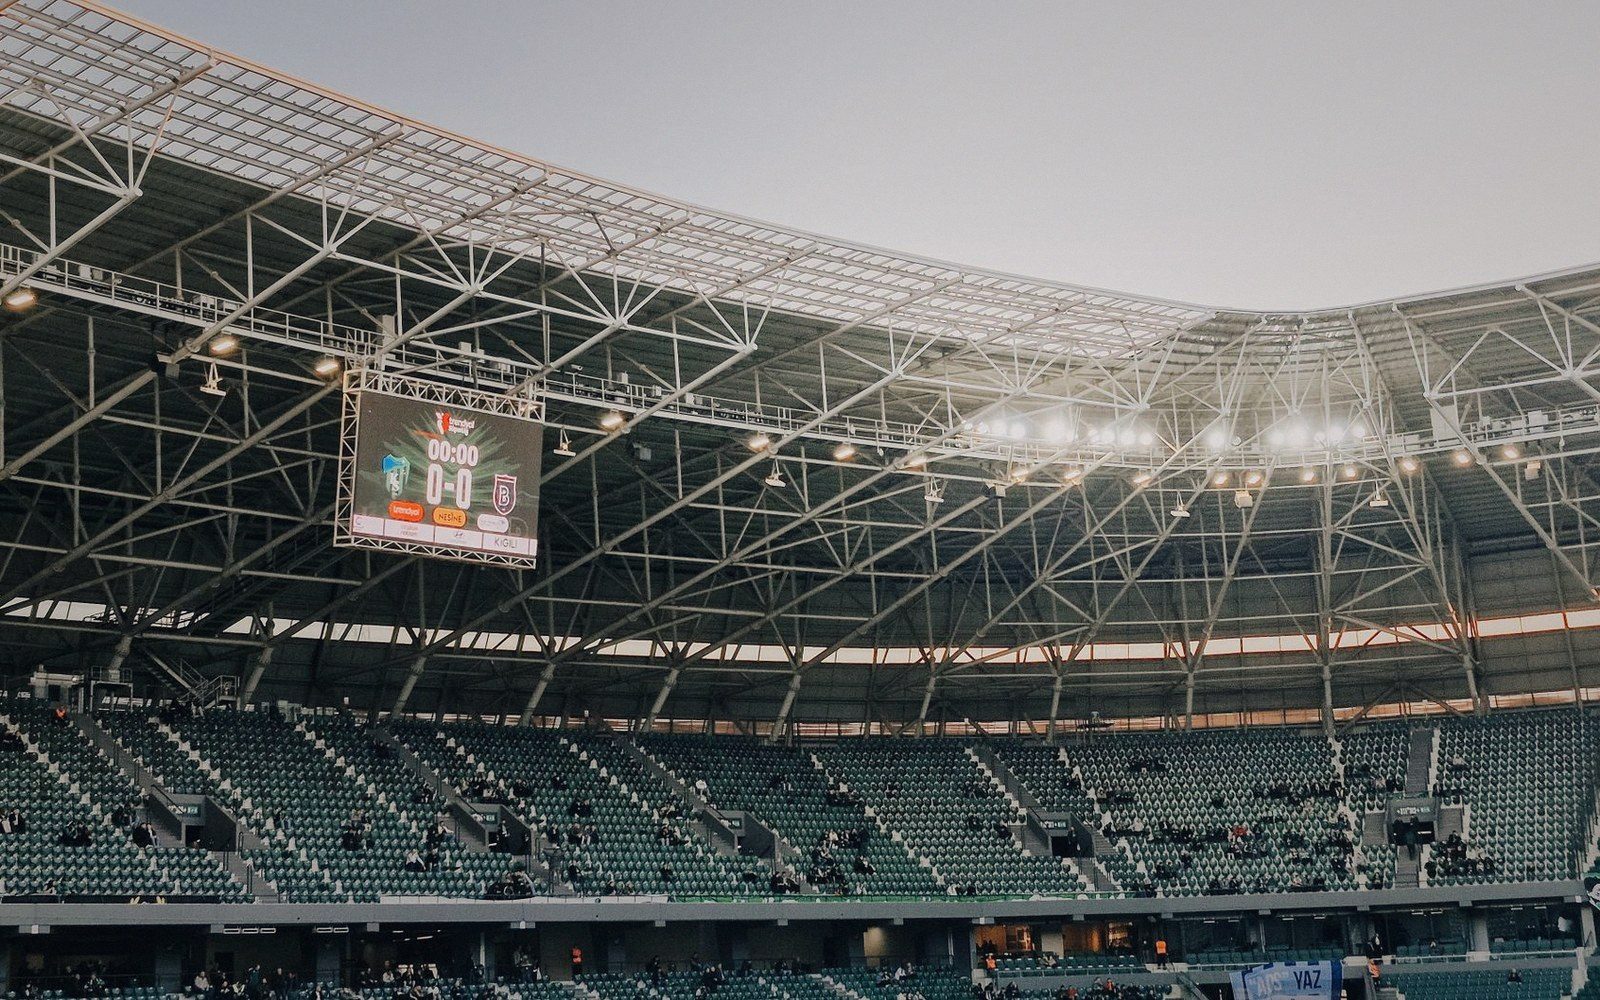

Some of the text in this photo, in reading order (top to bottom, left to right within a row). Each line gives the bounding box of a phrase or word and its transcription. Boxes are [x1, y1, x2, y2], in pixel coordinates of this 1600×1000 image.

[428, 438, 479, 467] 00:00
[426, 463, 472, 510] 0-0
[393, 505, 420, 517] trendyol
[1293, 969, 1322, 991] YAZ
